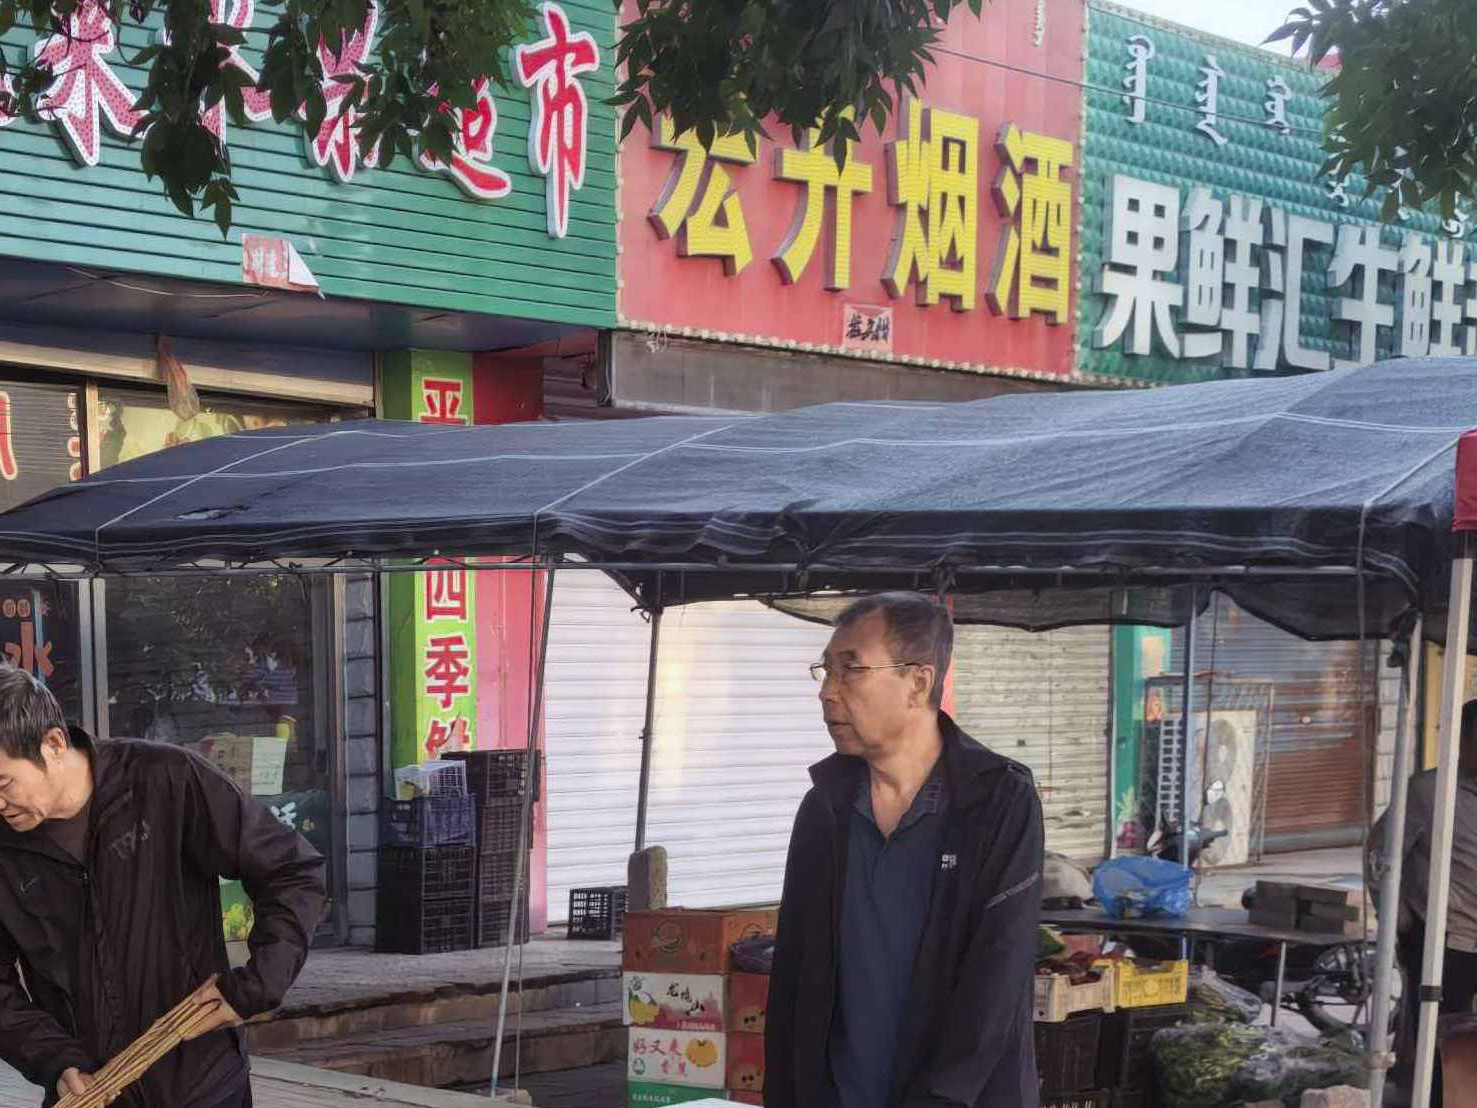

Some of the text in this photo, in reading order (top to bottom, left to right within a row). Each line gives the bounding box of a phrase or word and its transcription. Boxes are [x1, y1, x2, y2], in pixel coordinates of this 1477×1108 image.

[1094, 174, 1477, 372] 果鲜汇生鲜
